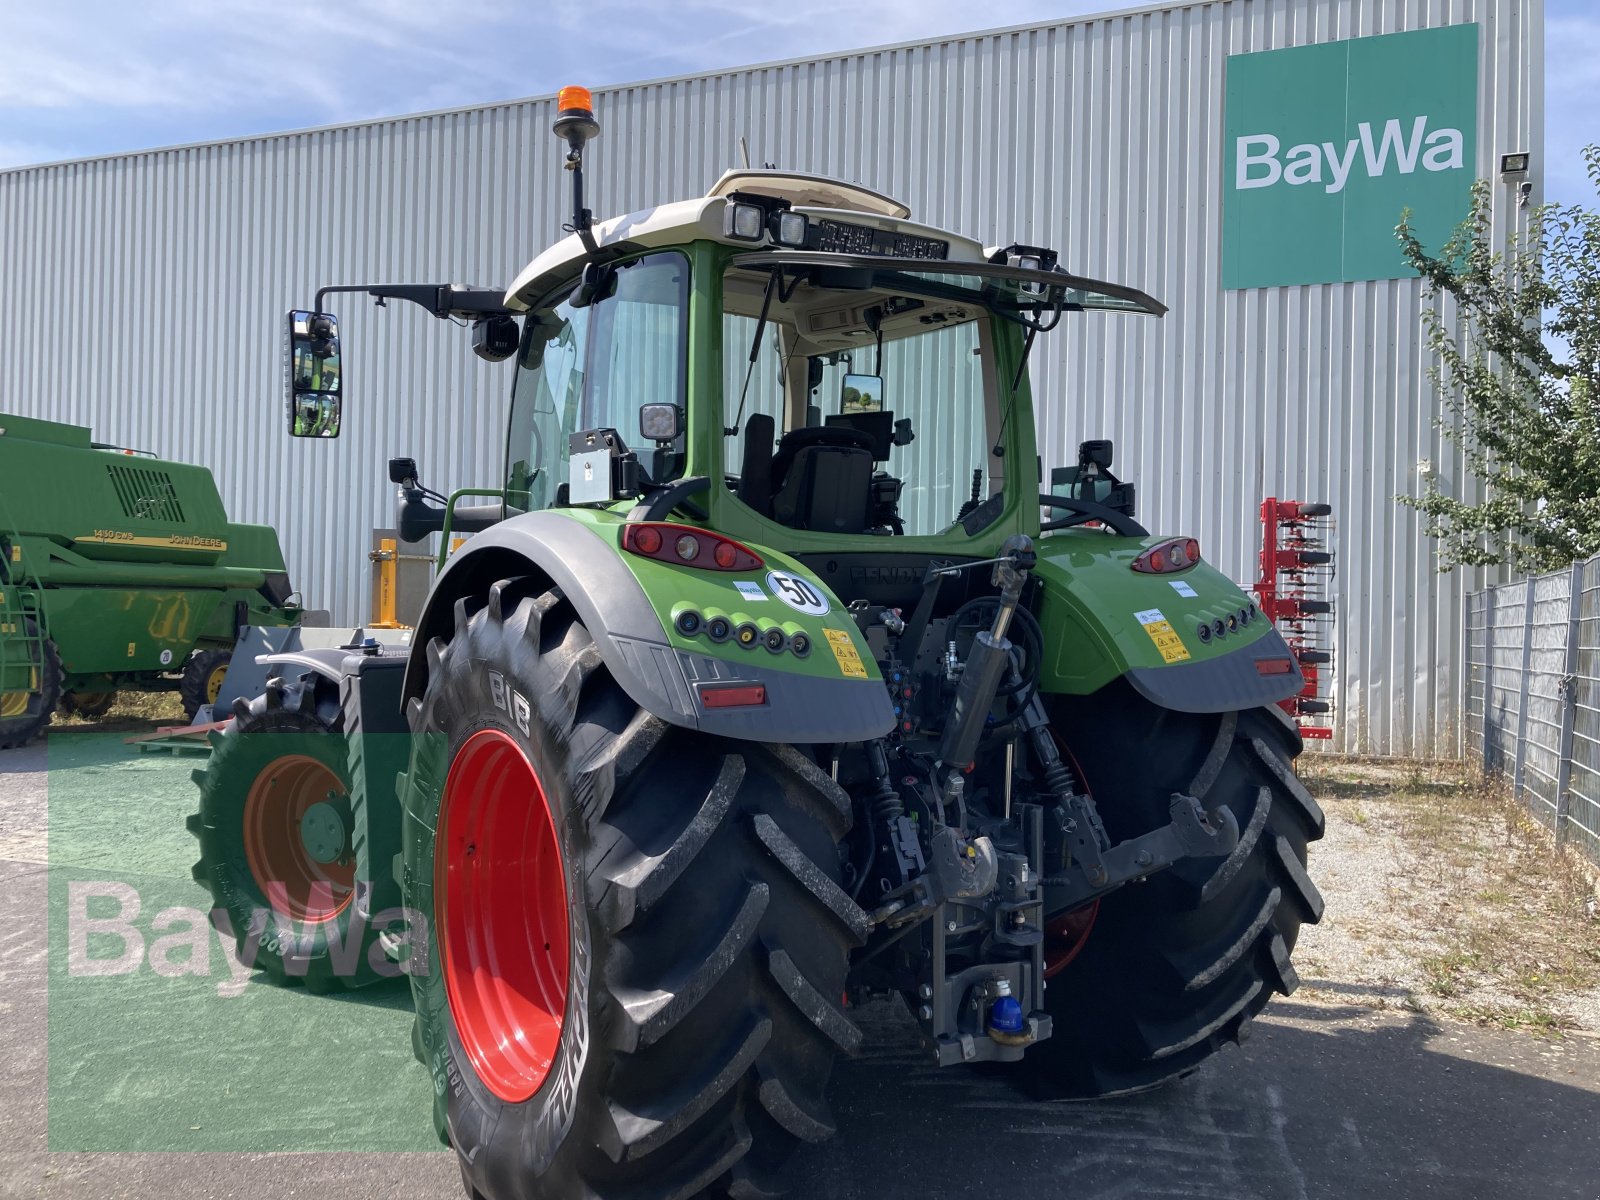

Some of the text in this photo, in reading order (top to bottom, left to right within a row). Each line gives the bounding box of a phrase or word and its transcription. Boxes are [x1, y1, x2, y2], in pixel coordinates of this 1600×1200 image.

[1236, 116, 1464, 194] BayWa
[115, 531, 134, 540] CWS
[169, 534, 222, 548] JOHN DEERE
[849, 567, 928, 585] FENDT
[774, 577, 822, 608] 50
[487, 668, 531, 738] BIB
